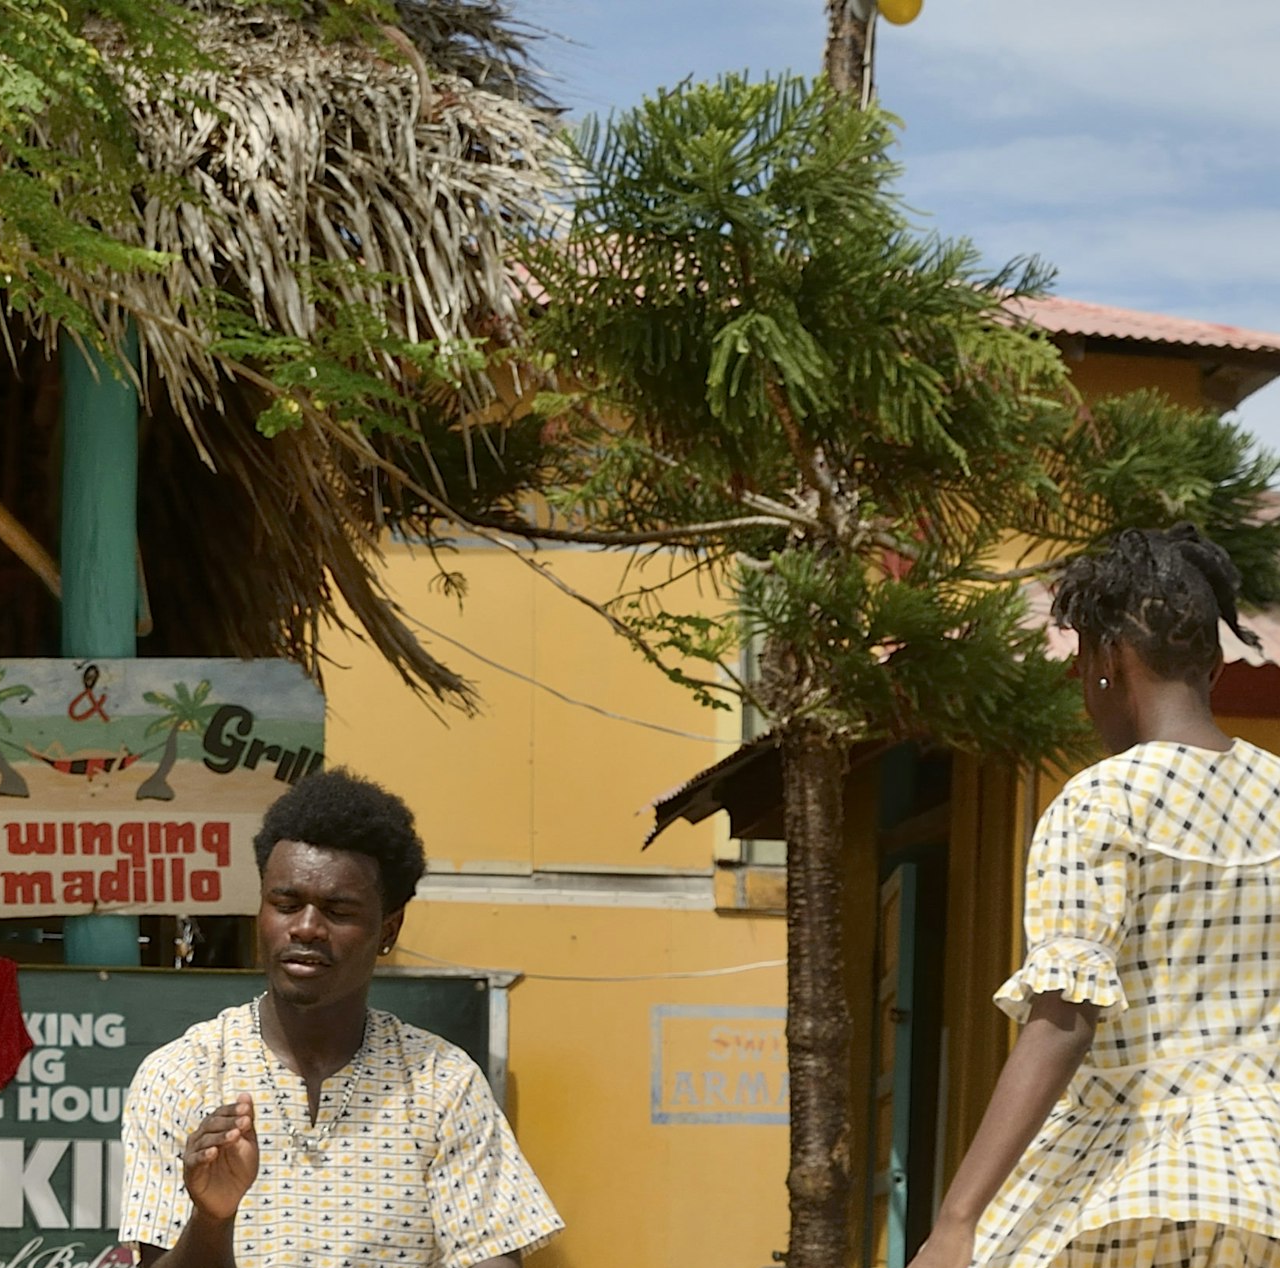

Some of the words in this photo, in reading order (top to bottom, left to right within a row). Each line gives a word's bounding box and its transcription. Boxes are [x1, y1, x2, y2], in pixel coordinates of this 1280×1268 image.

[68, 664, 111, 723] &
[203, 704, 324, 787] Grill
[22, 1012, 126, 1048] KING
[708, 1024, 785, 1062] SWI
[18, 1086, 130, 1122] HOU
[671, 1071, 790, 1105] ARMA
